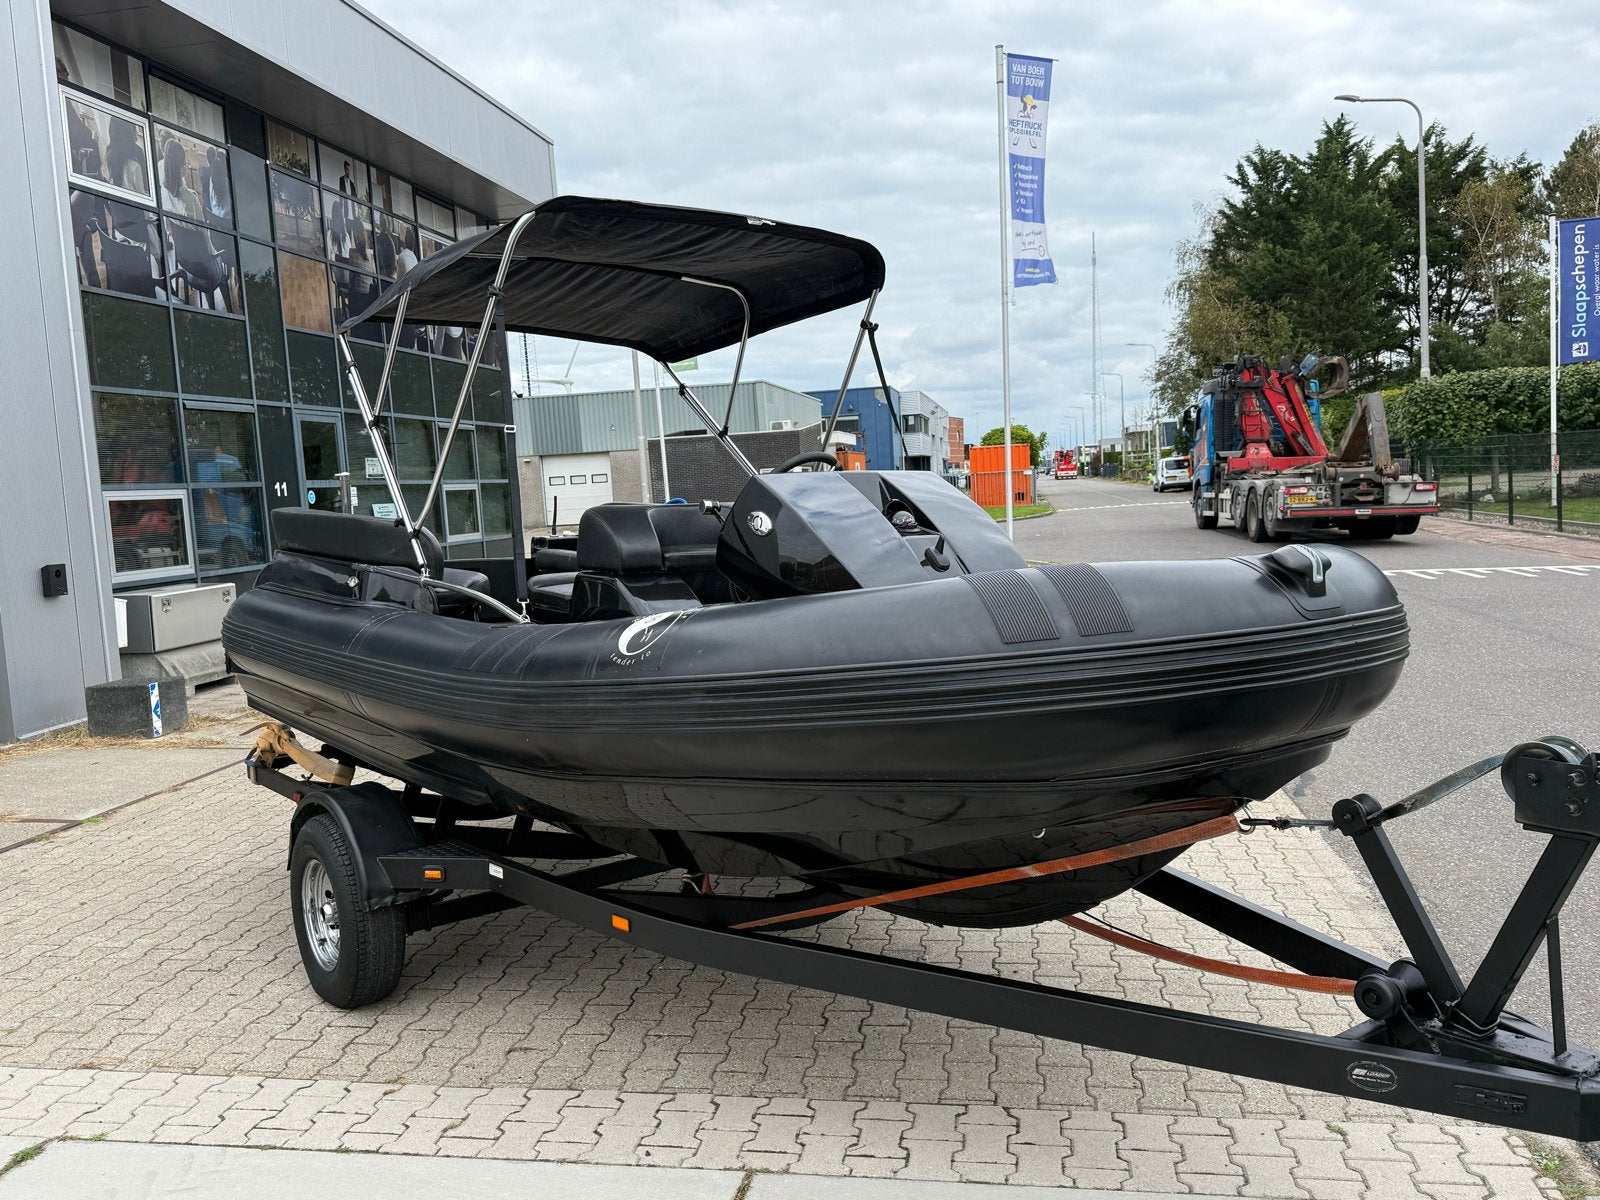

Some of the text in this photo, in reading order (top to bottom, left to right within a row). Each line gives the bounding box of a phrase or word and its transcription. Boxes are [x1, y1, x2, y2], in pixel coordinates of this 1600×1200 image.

[1012, 63, 1045, 76] VAN BOER
[1010, 75, 1045, 88] TOT BOUW
[1008, 117, 1042, 131] HEFTRUCK
[1572, 223, 1591, 338] Slaapschepen
[274, 481, 288, 497] 11
